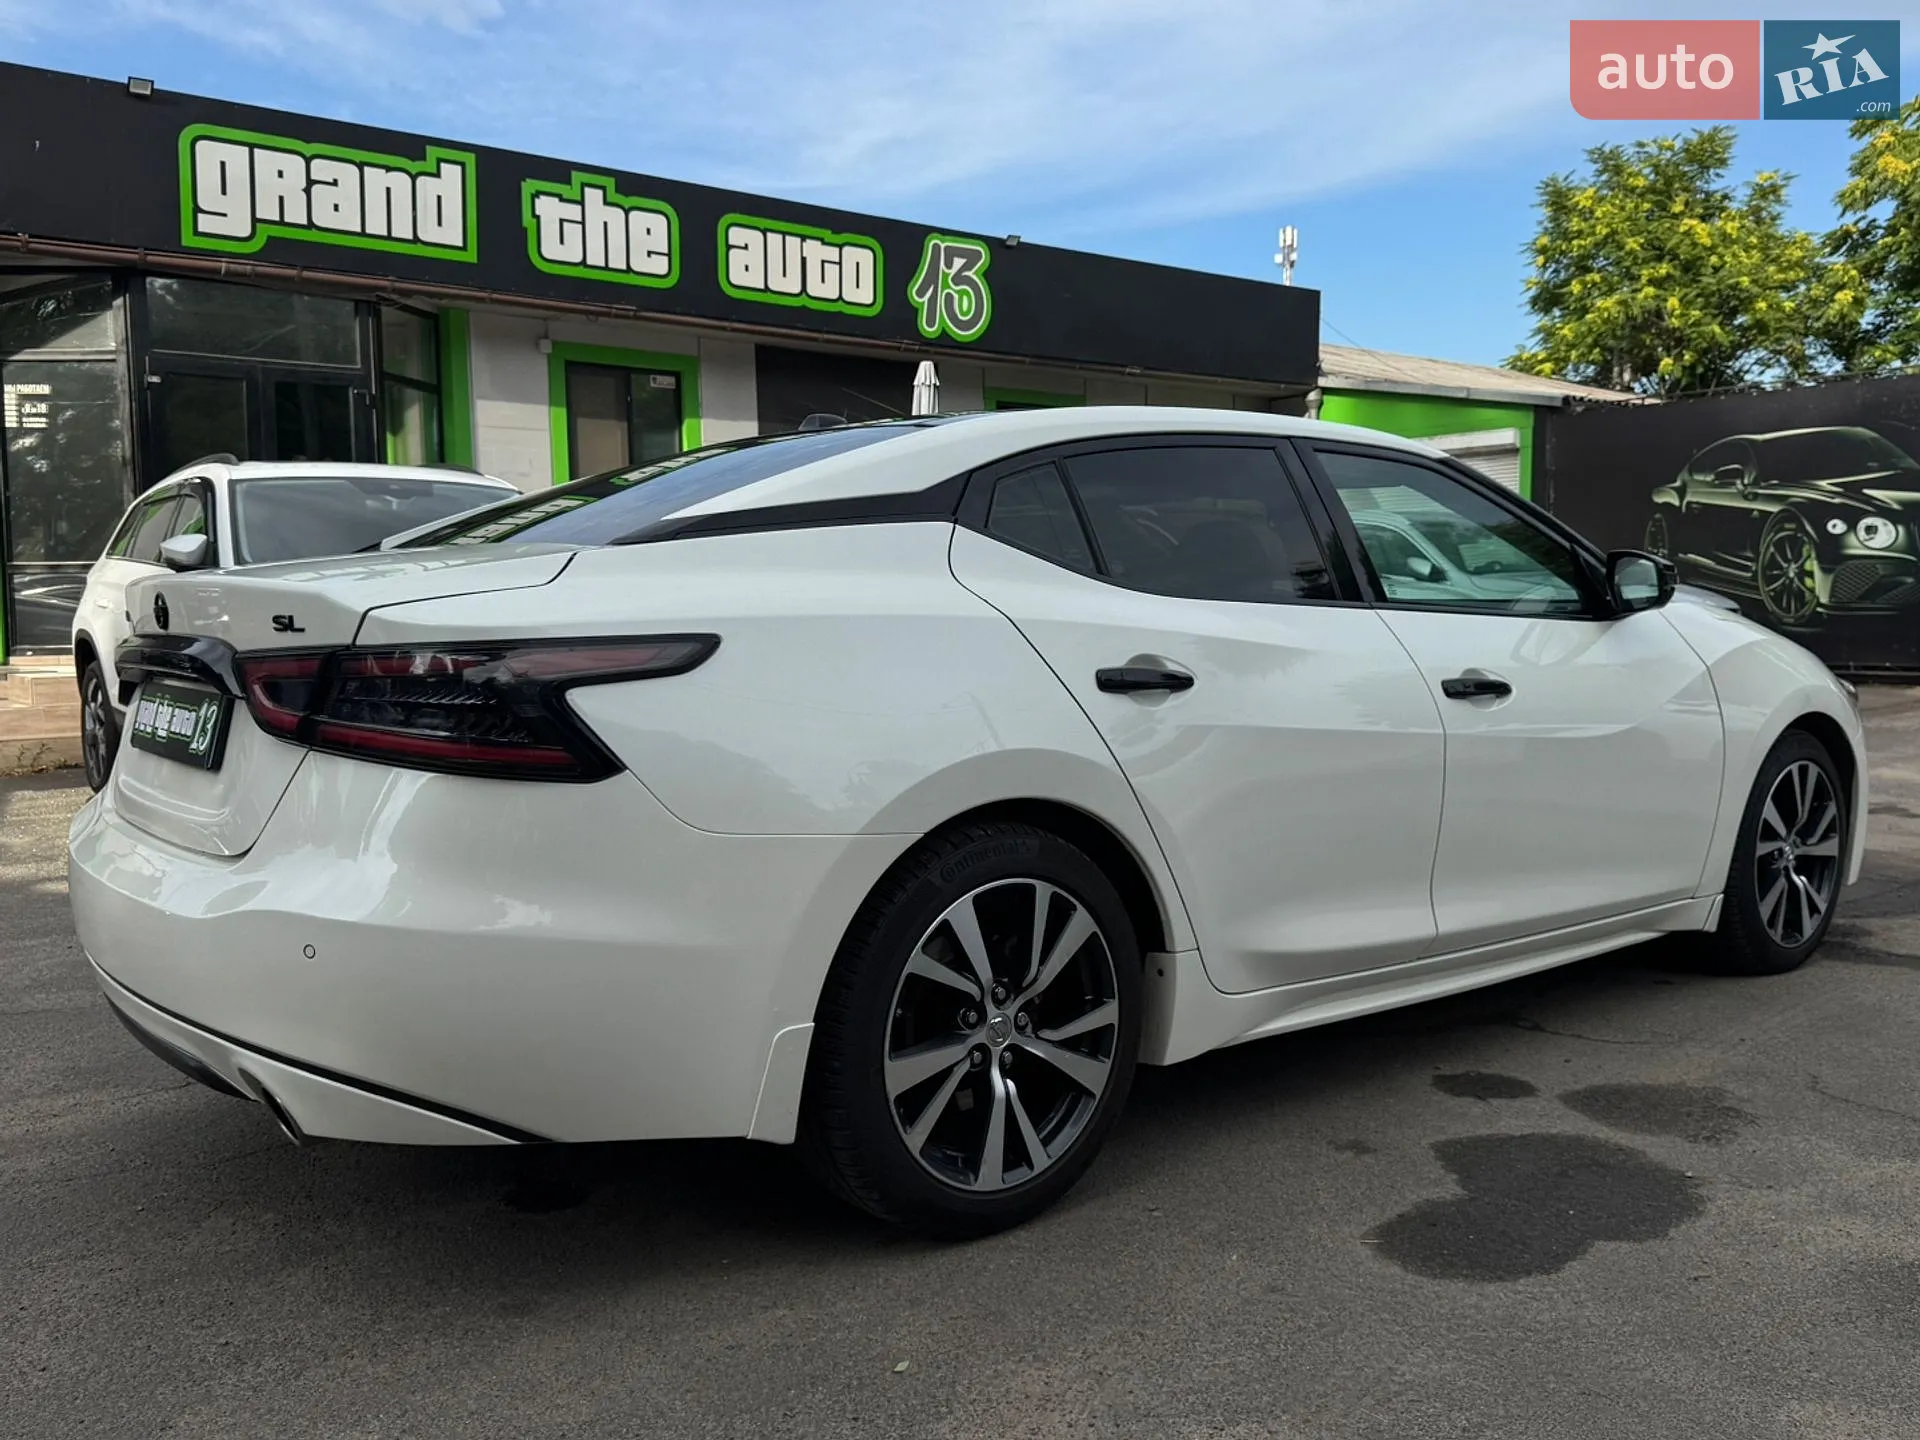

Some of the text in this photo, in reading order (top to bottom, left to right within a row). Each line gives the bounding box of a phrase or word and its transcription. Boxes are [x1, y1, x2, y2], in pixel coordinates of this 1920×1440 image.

[534, 183, 669, 277] the
[727, 225, 875, 306] auto
[912, 239, 988, 335] 13
[271, 614, 306, 633] SL
[189, 702, 218, 751] 13
